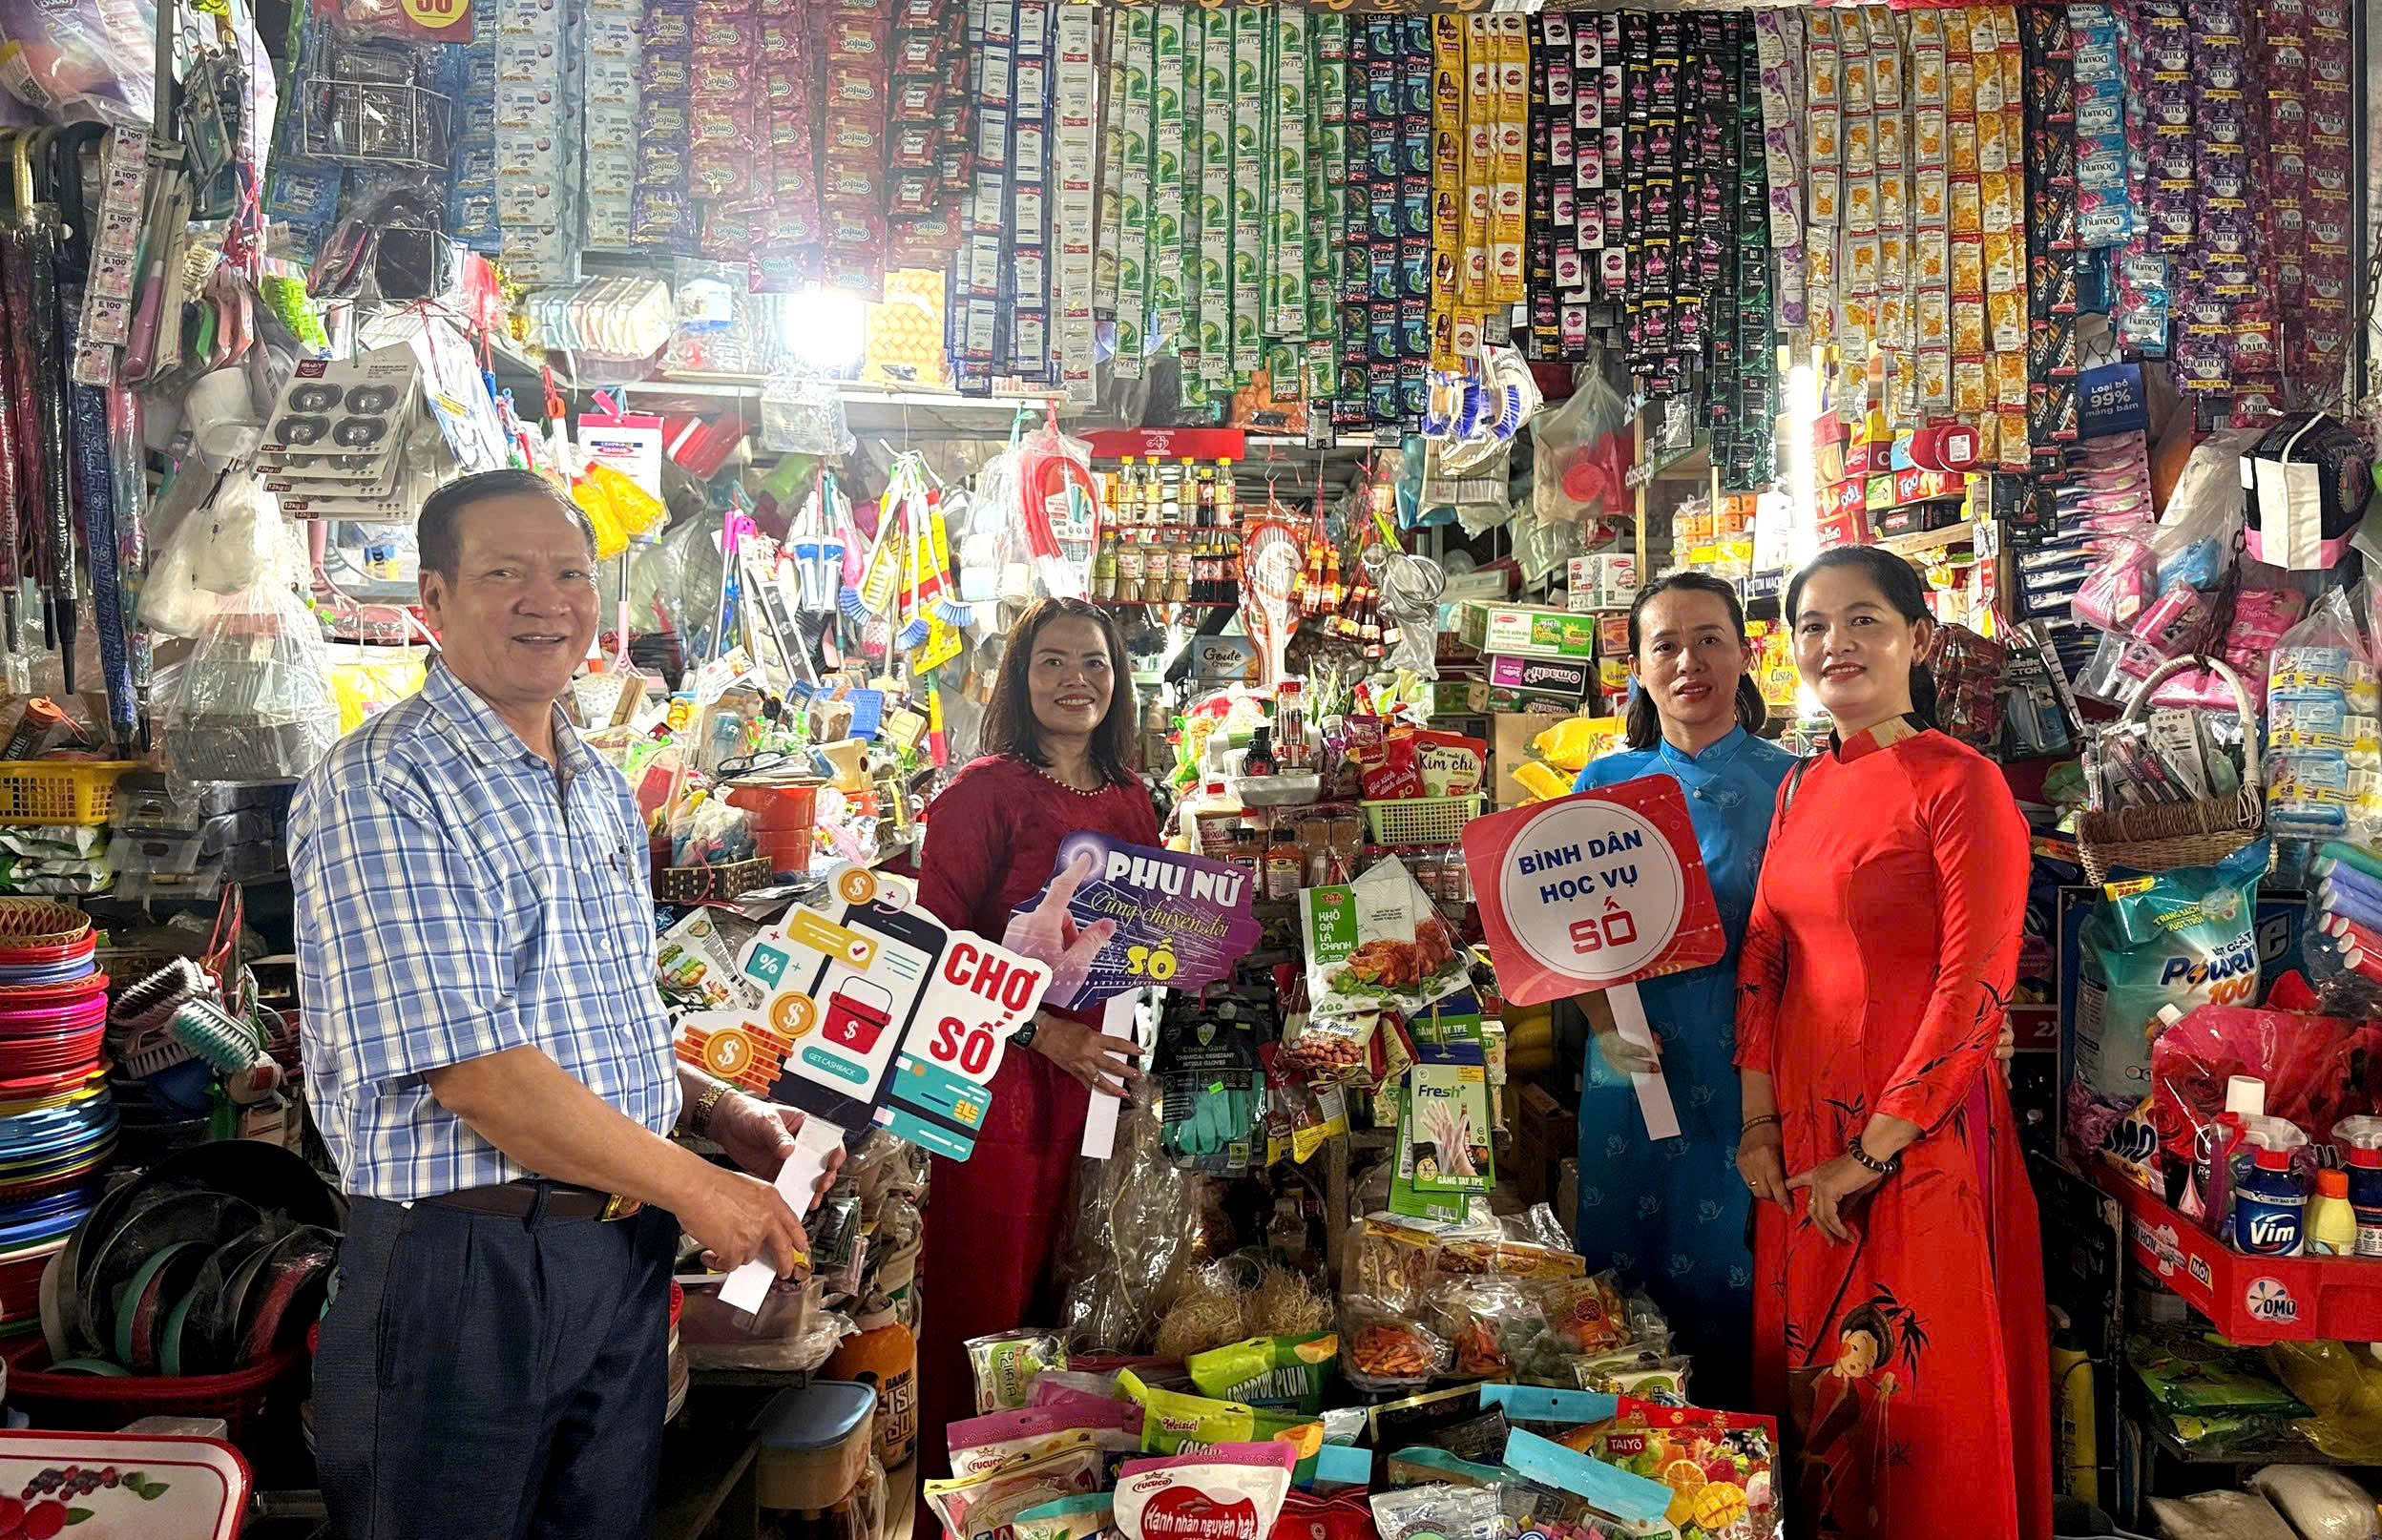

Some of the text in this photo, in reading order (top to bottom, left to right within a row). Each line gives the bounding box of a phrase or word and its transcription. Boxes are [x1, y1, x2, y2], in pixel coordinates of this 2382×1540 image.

[841, 39, 876, 52] Comfort
[2073, 54, 2108, 69] Downy
[1370, 69, 1394, 79] CLEAR
[840, 86, 875, 98] Comfort
[2078, 108, 2112, 120] Downy
[838, 133, 873, 145] Comfort
[1371, 129, 1395, 138] CLEAR
[2081, 161, 2116, 175] Downy
[836, 179, 871, 192] Comfort
[1371, 191, 1395, 200] CLEAR
[2084, 216, 2120, 229] Downy
[835, 227, 870, 240] Comfort
[1371, 253, 1395, 262] CLEAR
[2130, 261, 2163, 275] Downy
[1371, 312, 1395, 322] CLEAR
[2128, 316, 2161, 330] Downy
[2091, 383, 2113, 394] Loại
[2090, 388, 2131, 408] 99%
[1899, 473, 1918, 497] Tipo
[1107, 484, 1116, 509] Blendy
[1533, 666, 1581, 684] Omachi
[1419, 753, 1475, 771] Kim chi
[1518, 829, 1643, 876] BÌNH DÂN
[1105, 850, 1245, 907] PHỤ NỮ
[1539, 864, 1639, 904] HỌC VỤ
[1318, 908, 1341, 922] KHÔ
[1319, 921, 1335, 931] GÀ
[1568, 896, 1638, 955] SỐ
[1320, 931, 1332, 943] LÁ
[1320, 941, 1352, 951] CHANH
[1127, 936, 1178, 981] SỐ
[2160, 945, 2255, 988] Power
[944, 942, 1041, 1020] CHỢ
[2207, 975, 2254, 1005] 100
[1453, 1024, 1468, 1033] TPE
[930, 1015, 1006, 1075] SỐ
[808, 1051, 856, 1077] GET CASHBACK
[1457, 1175, 1470, 1185] TAY
[1471, 1176, 1484, 1186] TPE
[2249, 1220, 2296, 1246] Vim
[2190, 1255, 2211, 1285] MỚI
[2263, 1299, 2297, 1317] OMO
[1275, 1365, 1310, 1397] PLUM
[1145, 1503, 1257, 1540] Hạnh nhân nguyên hạt
